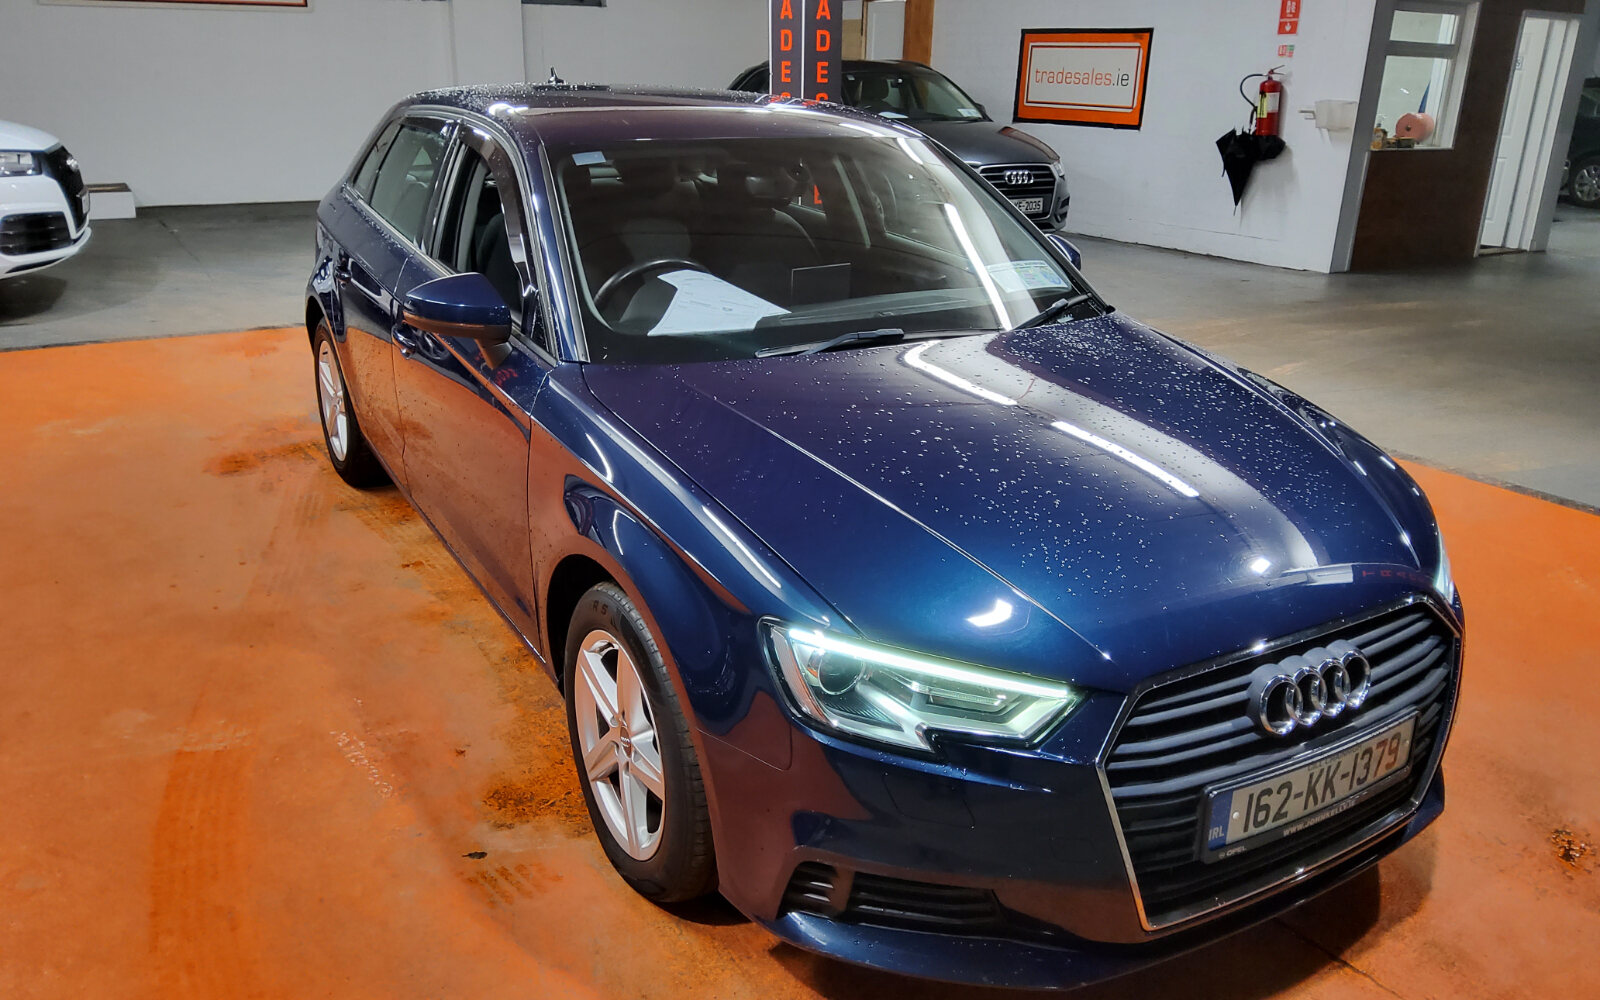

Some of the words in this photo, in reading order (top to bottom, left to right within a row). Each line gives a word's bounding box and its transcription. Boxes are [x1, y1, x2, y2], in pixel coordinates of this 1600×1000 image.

[1035, 67, 1130, 87] tradesales.ie
[1243, 732, 1401, 833] 162-KK-1379
[1208, 825, 1225, 840] IRL
